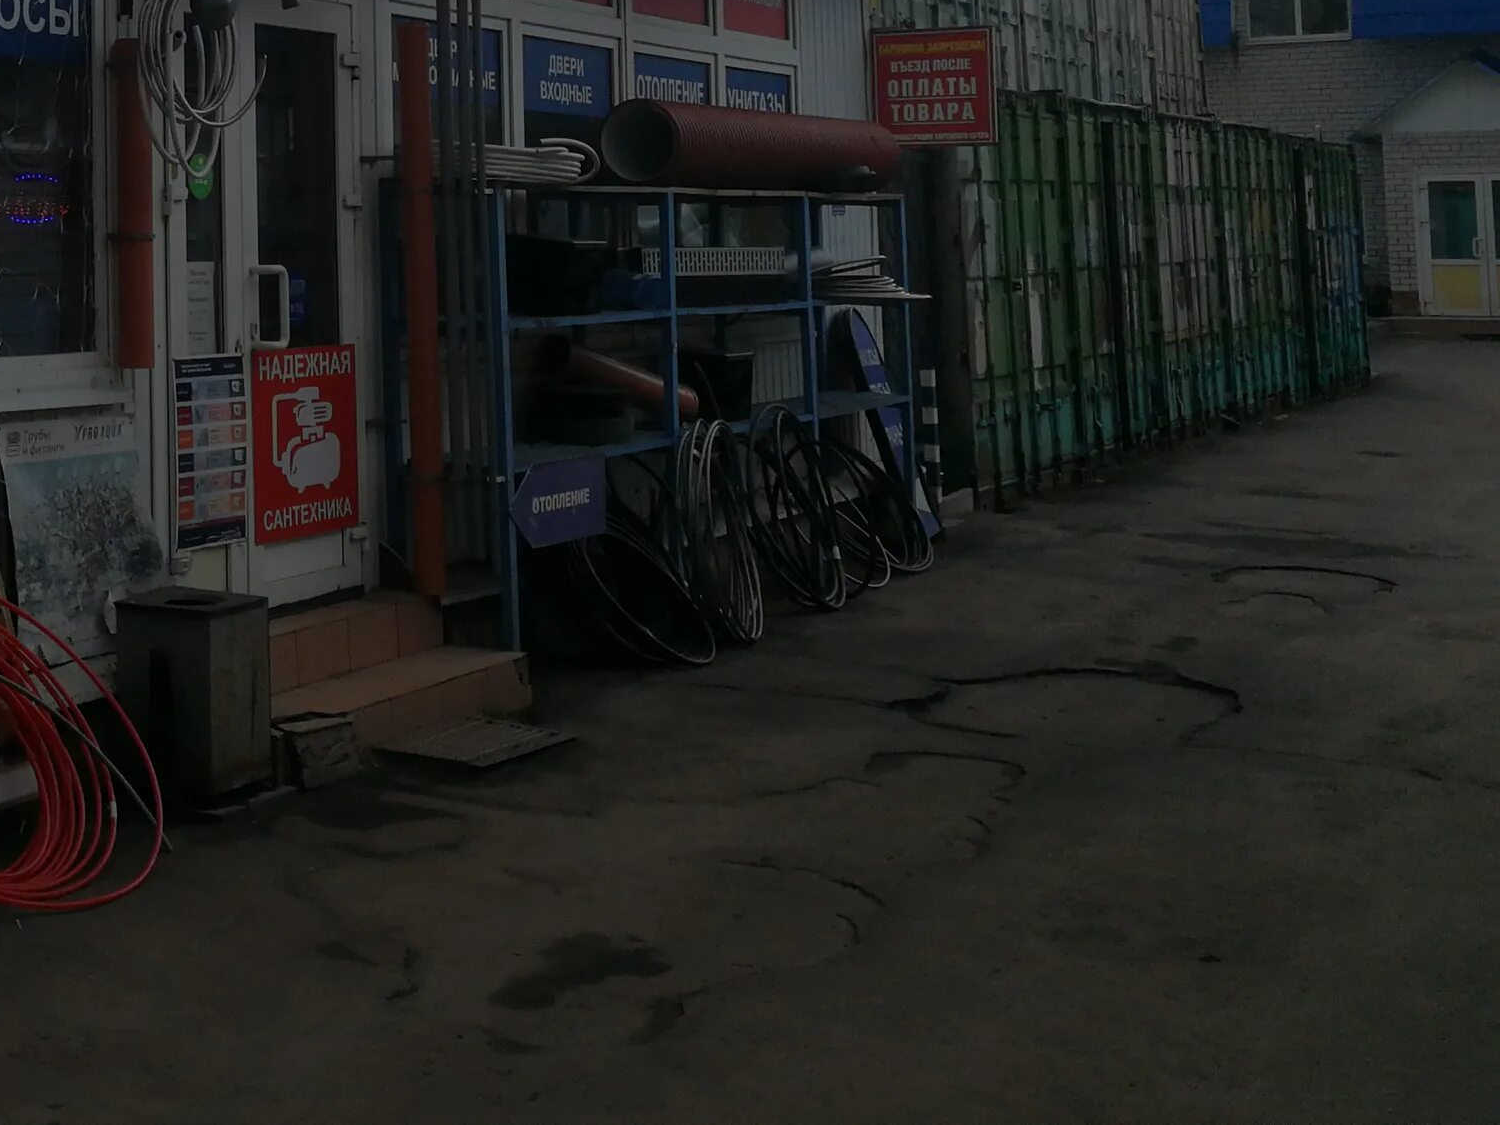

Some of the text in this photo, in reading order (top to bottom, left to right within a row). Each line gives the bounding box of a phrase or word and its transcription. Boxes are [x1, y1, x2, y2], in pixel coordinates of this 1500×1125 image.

[548, 54, 584, 77] ДВЕРИ
[890, 58, 972, 74] ВЪЕЗД ПОСЛЕ
[540, 80, 592, 104] ВХОДНЫЕ
[636, 74, 704, 104] ОТОПЛЕНИЕ
[887, 76, 977, 98] ОПЛАТЫ
[727, 87, 786, 113] УНИТАЗЫ
[890, 102, 975, 123] ТОВАРА
[259, 351, 351, 384] НАДЕЖНАЯ
[532, 487, 590, 514] ОТОПЛЕНИЕ
[264, 497, 352, 531] САНТЕХНИКА
